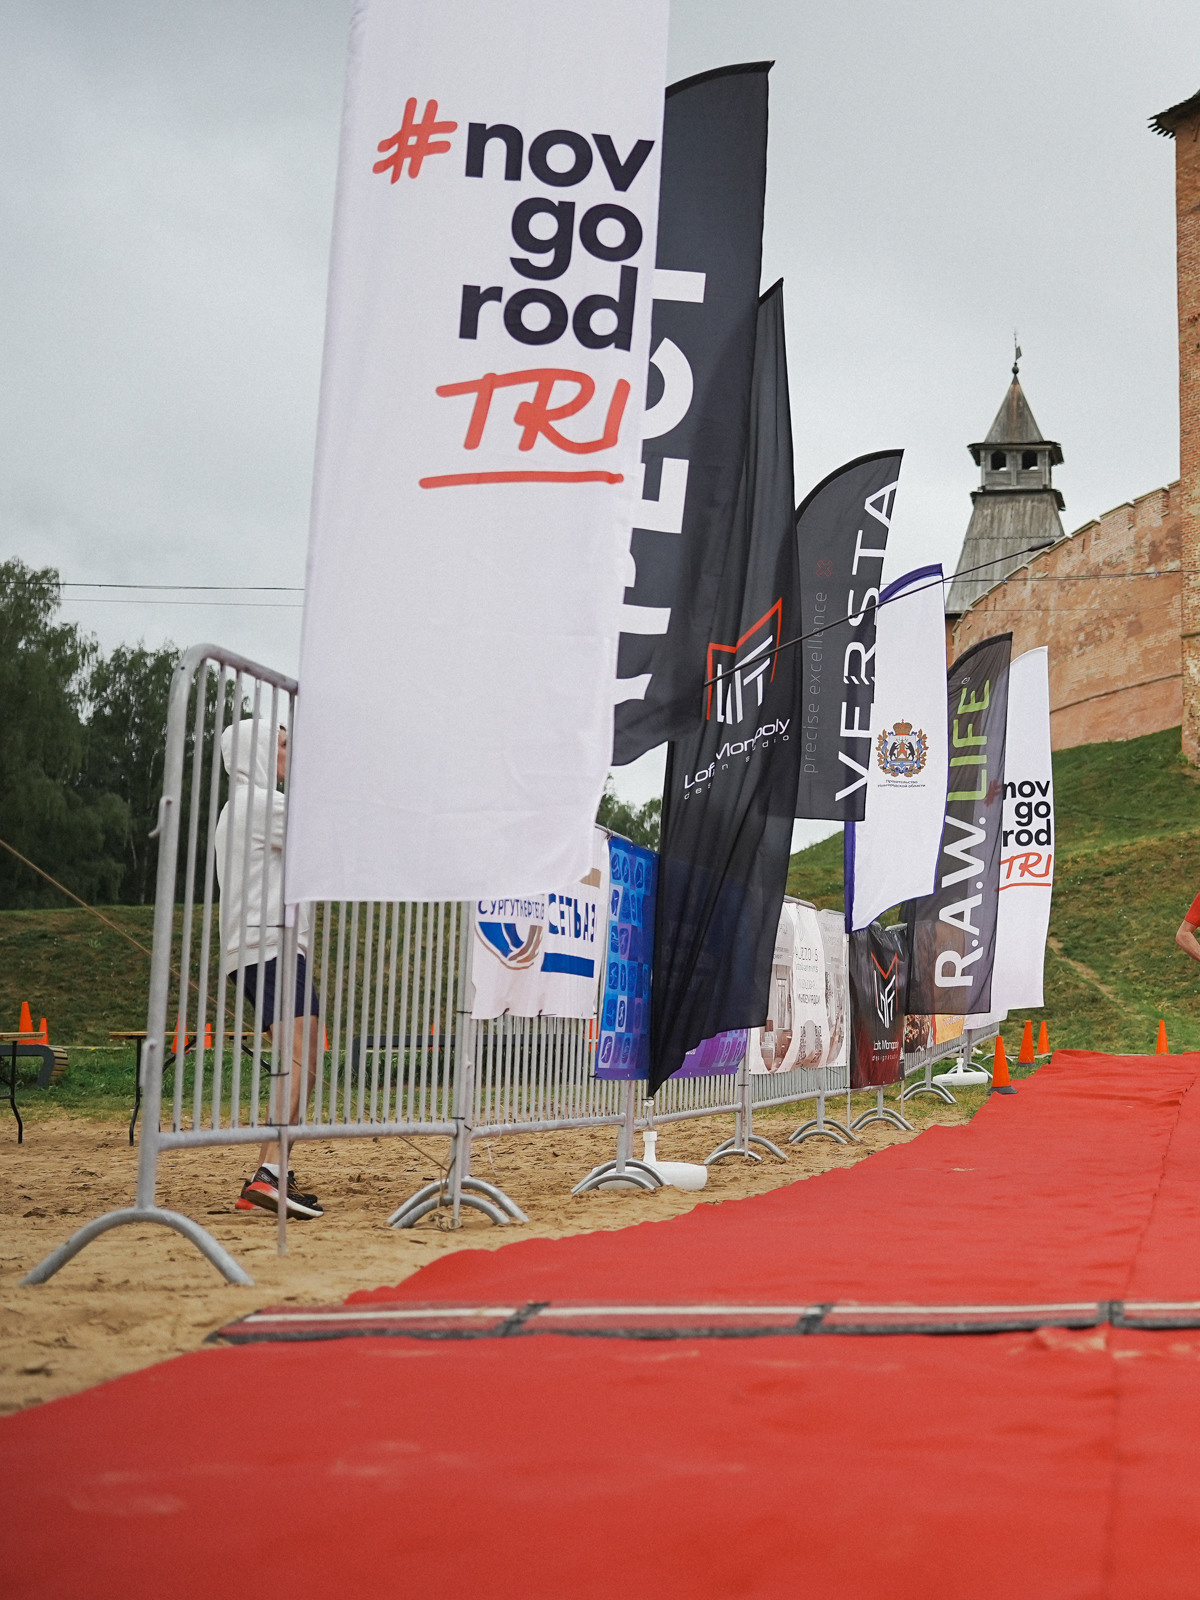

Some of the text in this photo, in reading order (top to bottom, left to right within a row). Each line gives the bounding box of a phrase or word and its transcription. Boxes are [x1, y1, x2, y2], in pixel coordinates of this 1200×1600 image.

[372, 97, 655, 193] #nov
[509, 196, 643, 281] go
[458, 264, 639, 352] rod
[435, 367, 631, 456] TRI
[803, 592, 827, 775] precise excellence
[835, 480, 898, 801] VERSTA
[946, 679, 991, 802] LIFE
[1003, 819, 1052, 848] rod
[1013, 801, 1051, 828] go
[1000, 852, 1052, 879] TRI
